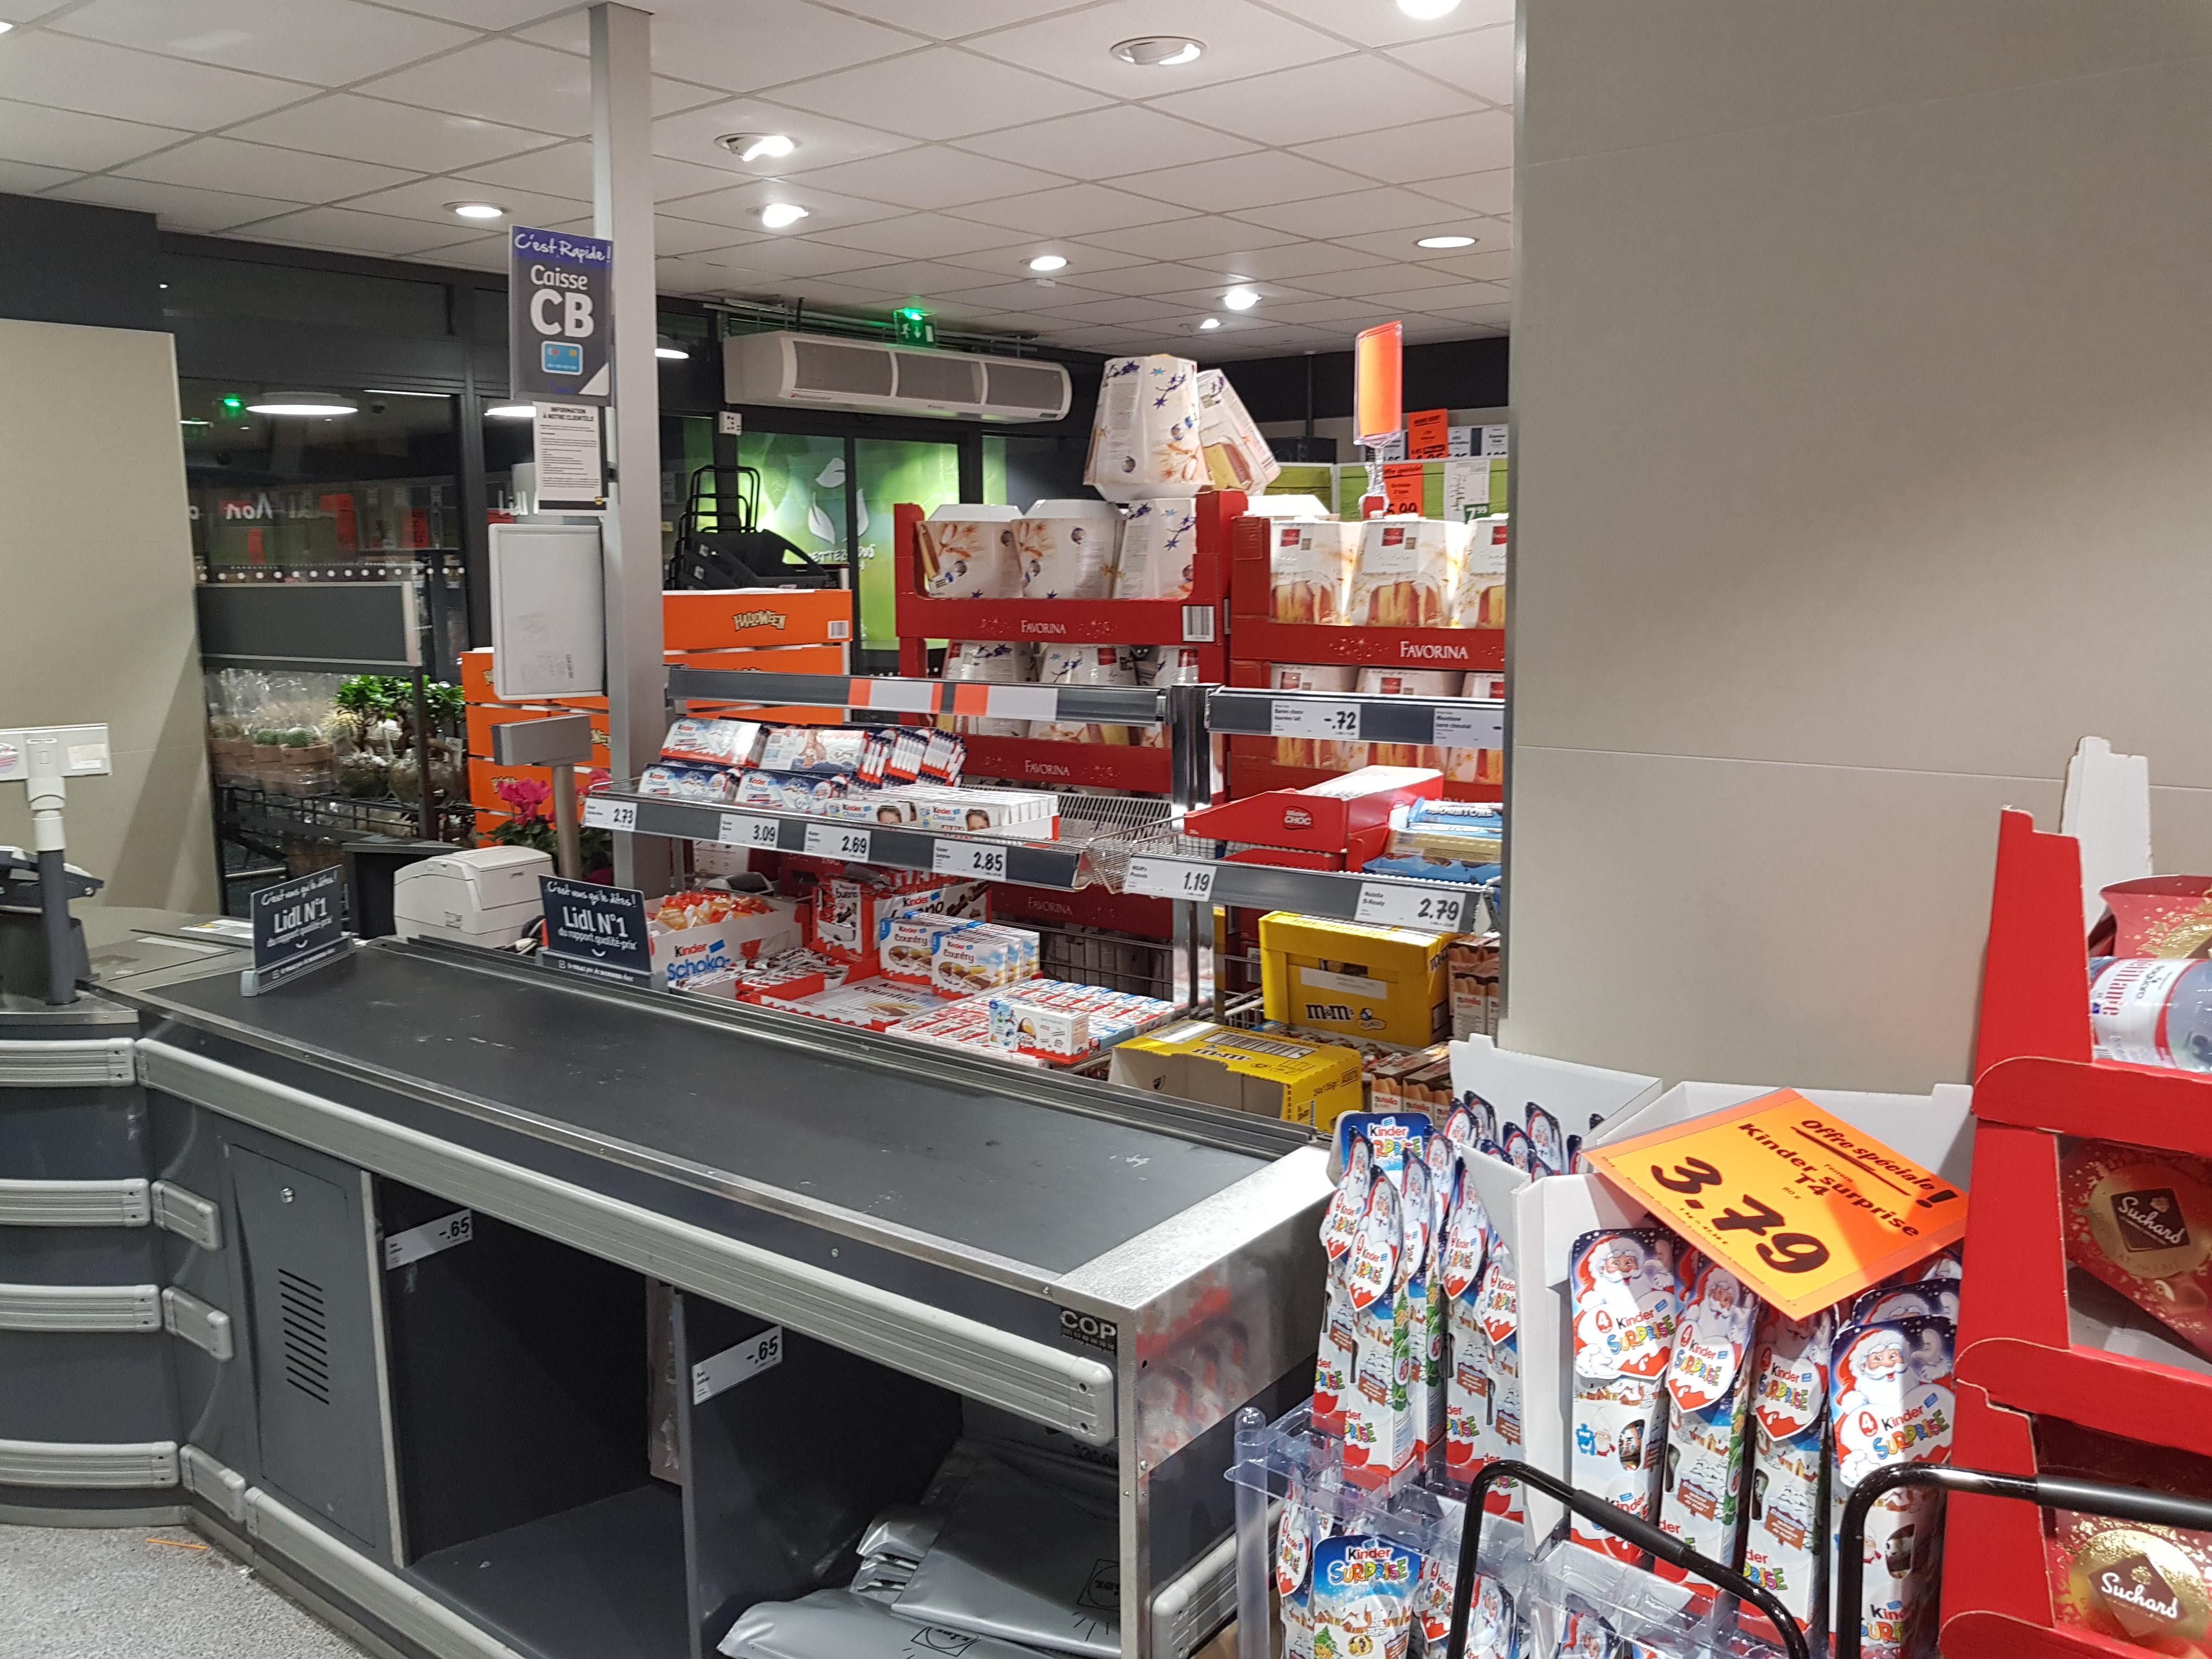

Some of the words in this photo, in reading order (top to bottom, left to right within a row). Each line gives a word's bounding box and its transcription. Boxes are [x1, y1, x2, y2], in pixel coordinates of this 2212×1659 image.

[515, 233, 557, 256] C'est
[530, 264, 588, 290] Caisse
[530, 289, 594, 337] CB
[1400, 640, 1469, 659] FAVORINA
[1323, 711, 1356, 730] -.72
[613, 807, 633, 823] 2.73
[1284, 816, 1312, 825] CHOC
[752, 823, 776, 842] 3.09
[841, 835, 867, 854] 2.69
[972, 851, 1003, 872] 2.85
[1183, 871, 1210, 892] 1.19
[902, 895, 930, 907] Kinder
[1417, 898, 1459, 921] 2.79
[274, 905, 302, 933] Lidl
[562, 906, 596, 932] Lidl
[674, 943, 708, 958] Kinder
[666, 953, 731, 981] Schoko-
[1370, 1124, 1407, 1137] Kinder
[1801, 1119, 1854, 1149] Offre
[1737, 1122, 1819, 1173] Kinder
[1818, 1176, 1920, 1237] surprise
[1794, 1173, 1831, 1197] T4
[1651, 1156, 1830, 1274] 3.79
[2117, 1196, 2185, 1244] Suchard
[439, 1216, 470, 1240] -.65
[1060, 1310, 1116, 1339] COP
[1616, 1308, 1656, 1331] Kinder
[1606, 1315, 1676, 1356] SURPRISE
[747, 1335, 778, 1364] -.65
[1690, 1339, 1717, 1360] Kinder
[1674, 1348, 1722, 1386] SURPRISE
[1770, 1362, 1801, 1383] Kinder
[1758, 1373, 1809, 1412] SURPRISE
[1881, 1405, 1924, 1431] Kinder
[1872, 1408, 1950, 1460] SURPRISE
[1347, 1547, 1392, 1560] Kinder
[1330, 1558, 1408, 1584] SURPRISE
[2100, 1571, 2180, 1619] Suchard
